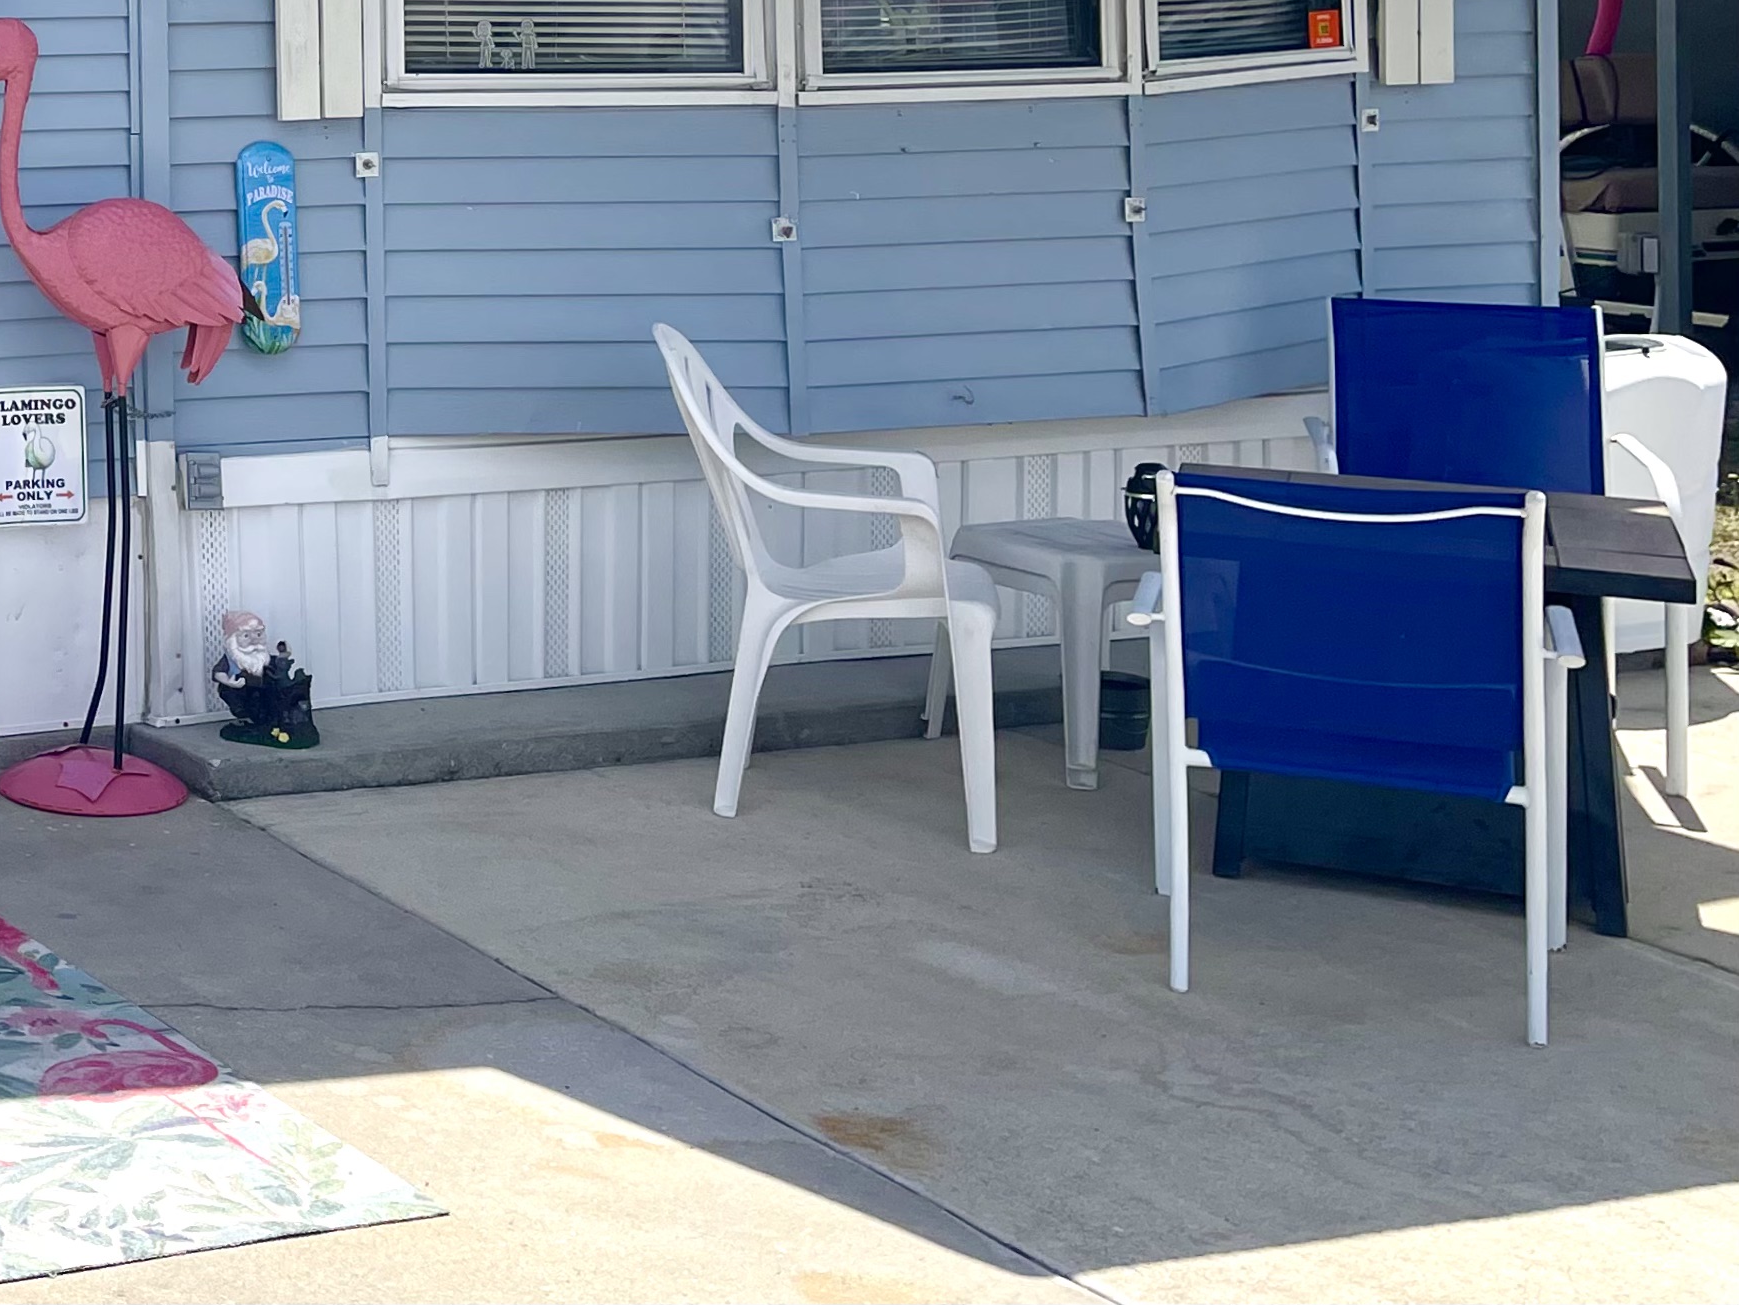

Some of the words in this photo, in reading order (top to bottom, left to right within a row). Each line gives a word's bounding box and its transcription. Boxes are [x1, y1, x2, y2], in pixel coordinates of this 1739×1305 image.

[246, 161, 290, 177] Welcome
[246, 184, 294, 206] PARADISE
[1, 413, 66, 426] LOVERS
[5, 478, 65, 490] PARKING
[16, 491, 53, 501] ONLY
